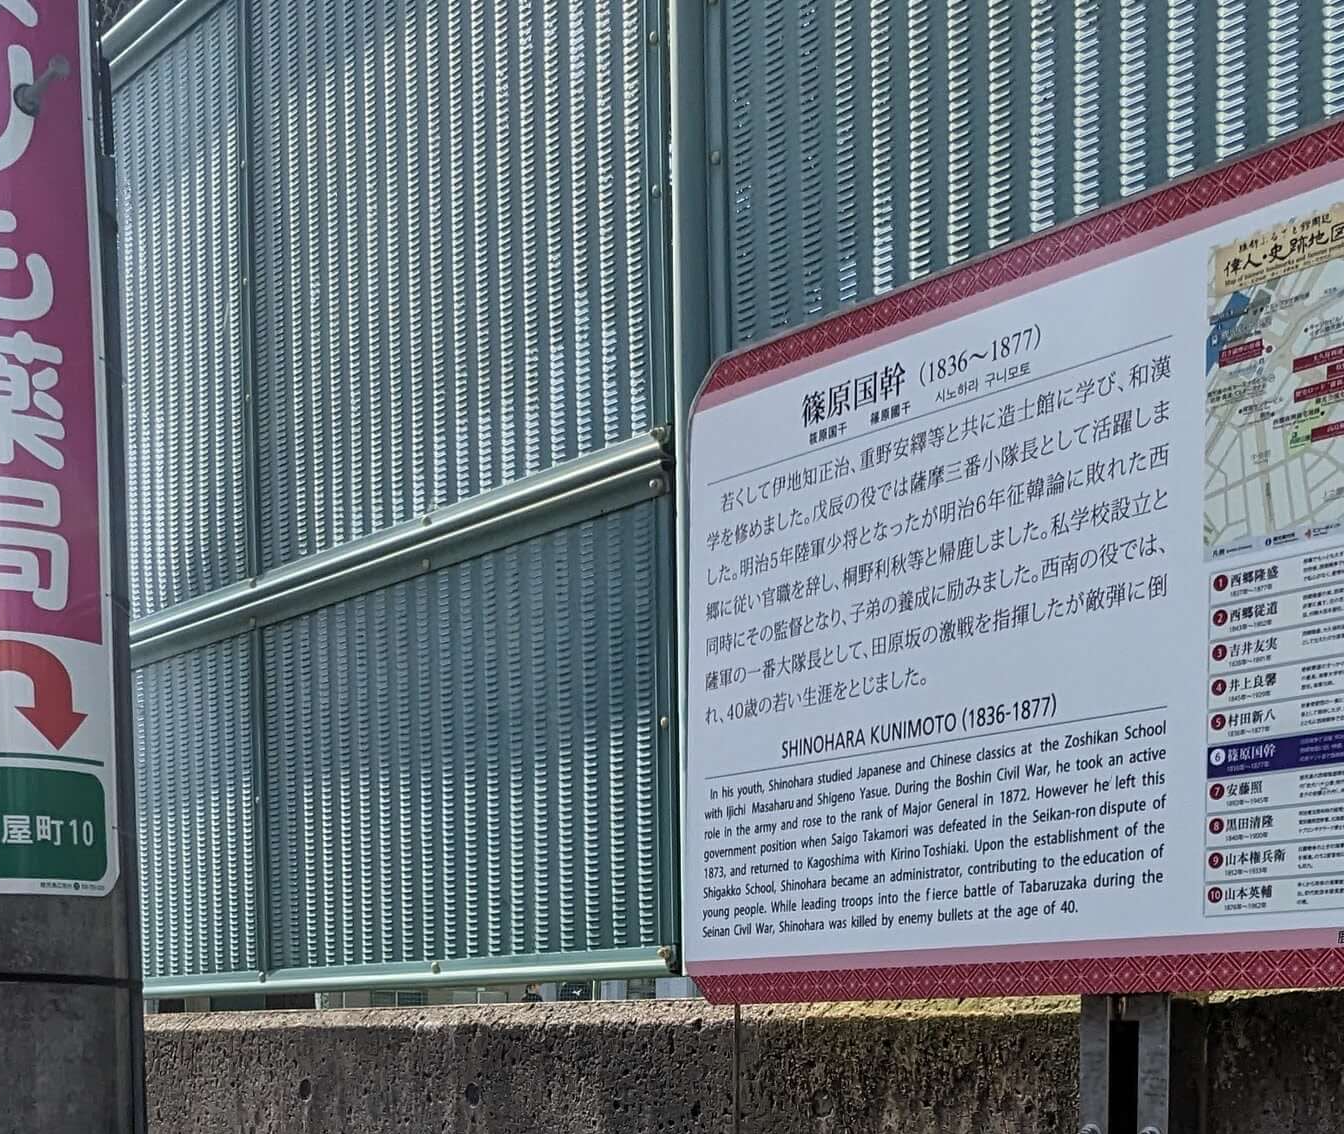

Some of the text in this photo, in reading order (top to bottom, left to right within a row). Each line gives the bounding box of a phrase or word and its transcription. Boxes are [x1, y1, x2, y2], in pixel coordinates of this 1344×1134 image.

[802, 361, 905, 427] 篠原国幹
[935, 361, 1030, 402] 시노하라 구니모토
[1228, 635, 1278, 658] 吉井友実
[704, 666, 926, 725] れ、40歳の若い生涯をとじました。
[1227, 707, 1276, 727] 村田新八
[781, 692, 1056, 759] SHINOHARA KUNIMOTO (1836-1877)
[704, 806, 722, 819] with
[751, 798, 794, 814] Masaharu
[795, 792, 813, 808] and
[816, 791, 855, 807] Shigeno
[859, 786, 890, 800] Yasue.
[894, 779, 929, 795] During
[933, 775, 951, 790] the
[955, 770, 992, 787] Boshin
[996, 764, 1020, 781] Civil
[1024, 762, 1051, 777] War,
[1055, 759, 1070, 773] he
[1074, 753, 1103, 771] took
[1107, 754, 1123, 766] an
[1128, 746, 1166, 764] active
[710, 719, 1166, 800] In his youth, Shinohara studied Japanese and Chinese classics at the Zoshikan School
[703, 793, 1166, 863] government position when Saigo Takamori was defeated in the Seikan-ron dispute of
[704, 770, 1165, 839] role the army and rose the rank of Major General in 1872. However left this
[703, 819, 1164, 879] 1873, and returned Kagoshima with Kirino Toshiaki. Upon the establishment of the
[703, 842, 1164, 901] Shigakko School, Shinohara became administrator, contributing to the education of
[702, 868, 1163, 921] young people. While leading troops into the fierce battle of Tabaruzaka during the
[702, 899, 1078, 937] Seinan Civil War, Shinohara was killed by enemy bullets at the age of 40.
